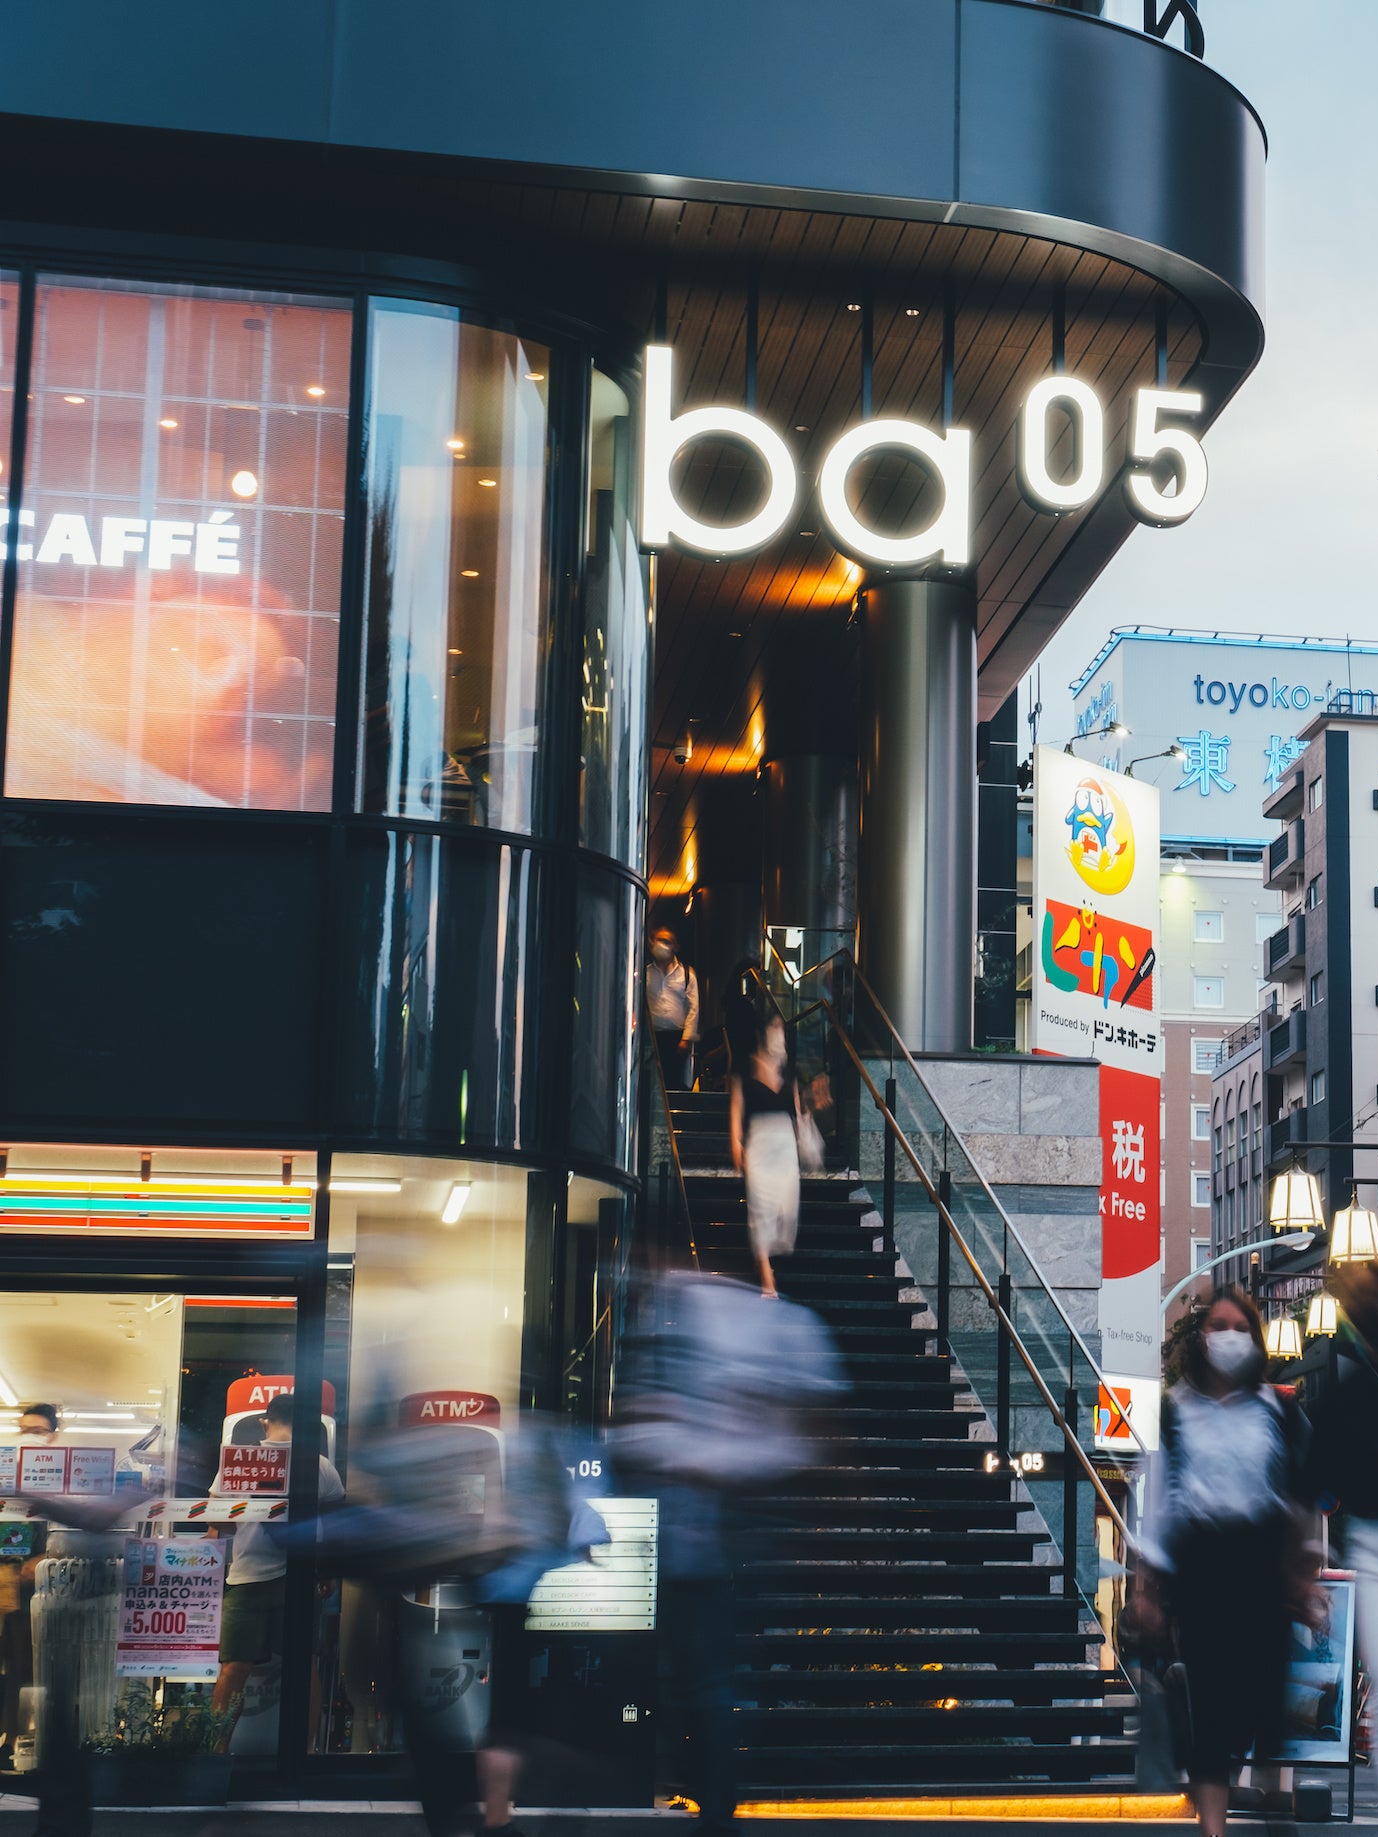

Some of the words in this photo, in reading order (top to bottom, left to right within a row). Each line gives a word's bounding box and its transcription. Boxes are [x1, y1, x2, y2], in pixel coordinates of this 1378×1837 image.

[640, 344, 972, 566] ba
[1023, 374, 1209, 520] 05
[1041, 1009, 1079, 1030] Produced
[1080, 1017, 1090, 1035] by
[1112, 1191, 1147, 1222] Free
[1106, 1327, 1135, 1341] Tax-free
[1135, 1329, 1153, 1346] Shop
[420, 1399, 467, 1417] ATM
[34, 1454, 54, 1463] ATM
[73, 1454, 91, 1464] Free
[232, 1448, 280, 1464] ATMは
[223, 1480, 258, 1491] あります
[158, 1574, 220, 1587] 店内ATMで
[132, 1610, 187, 1635] 5,000
